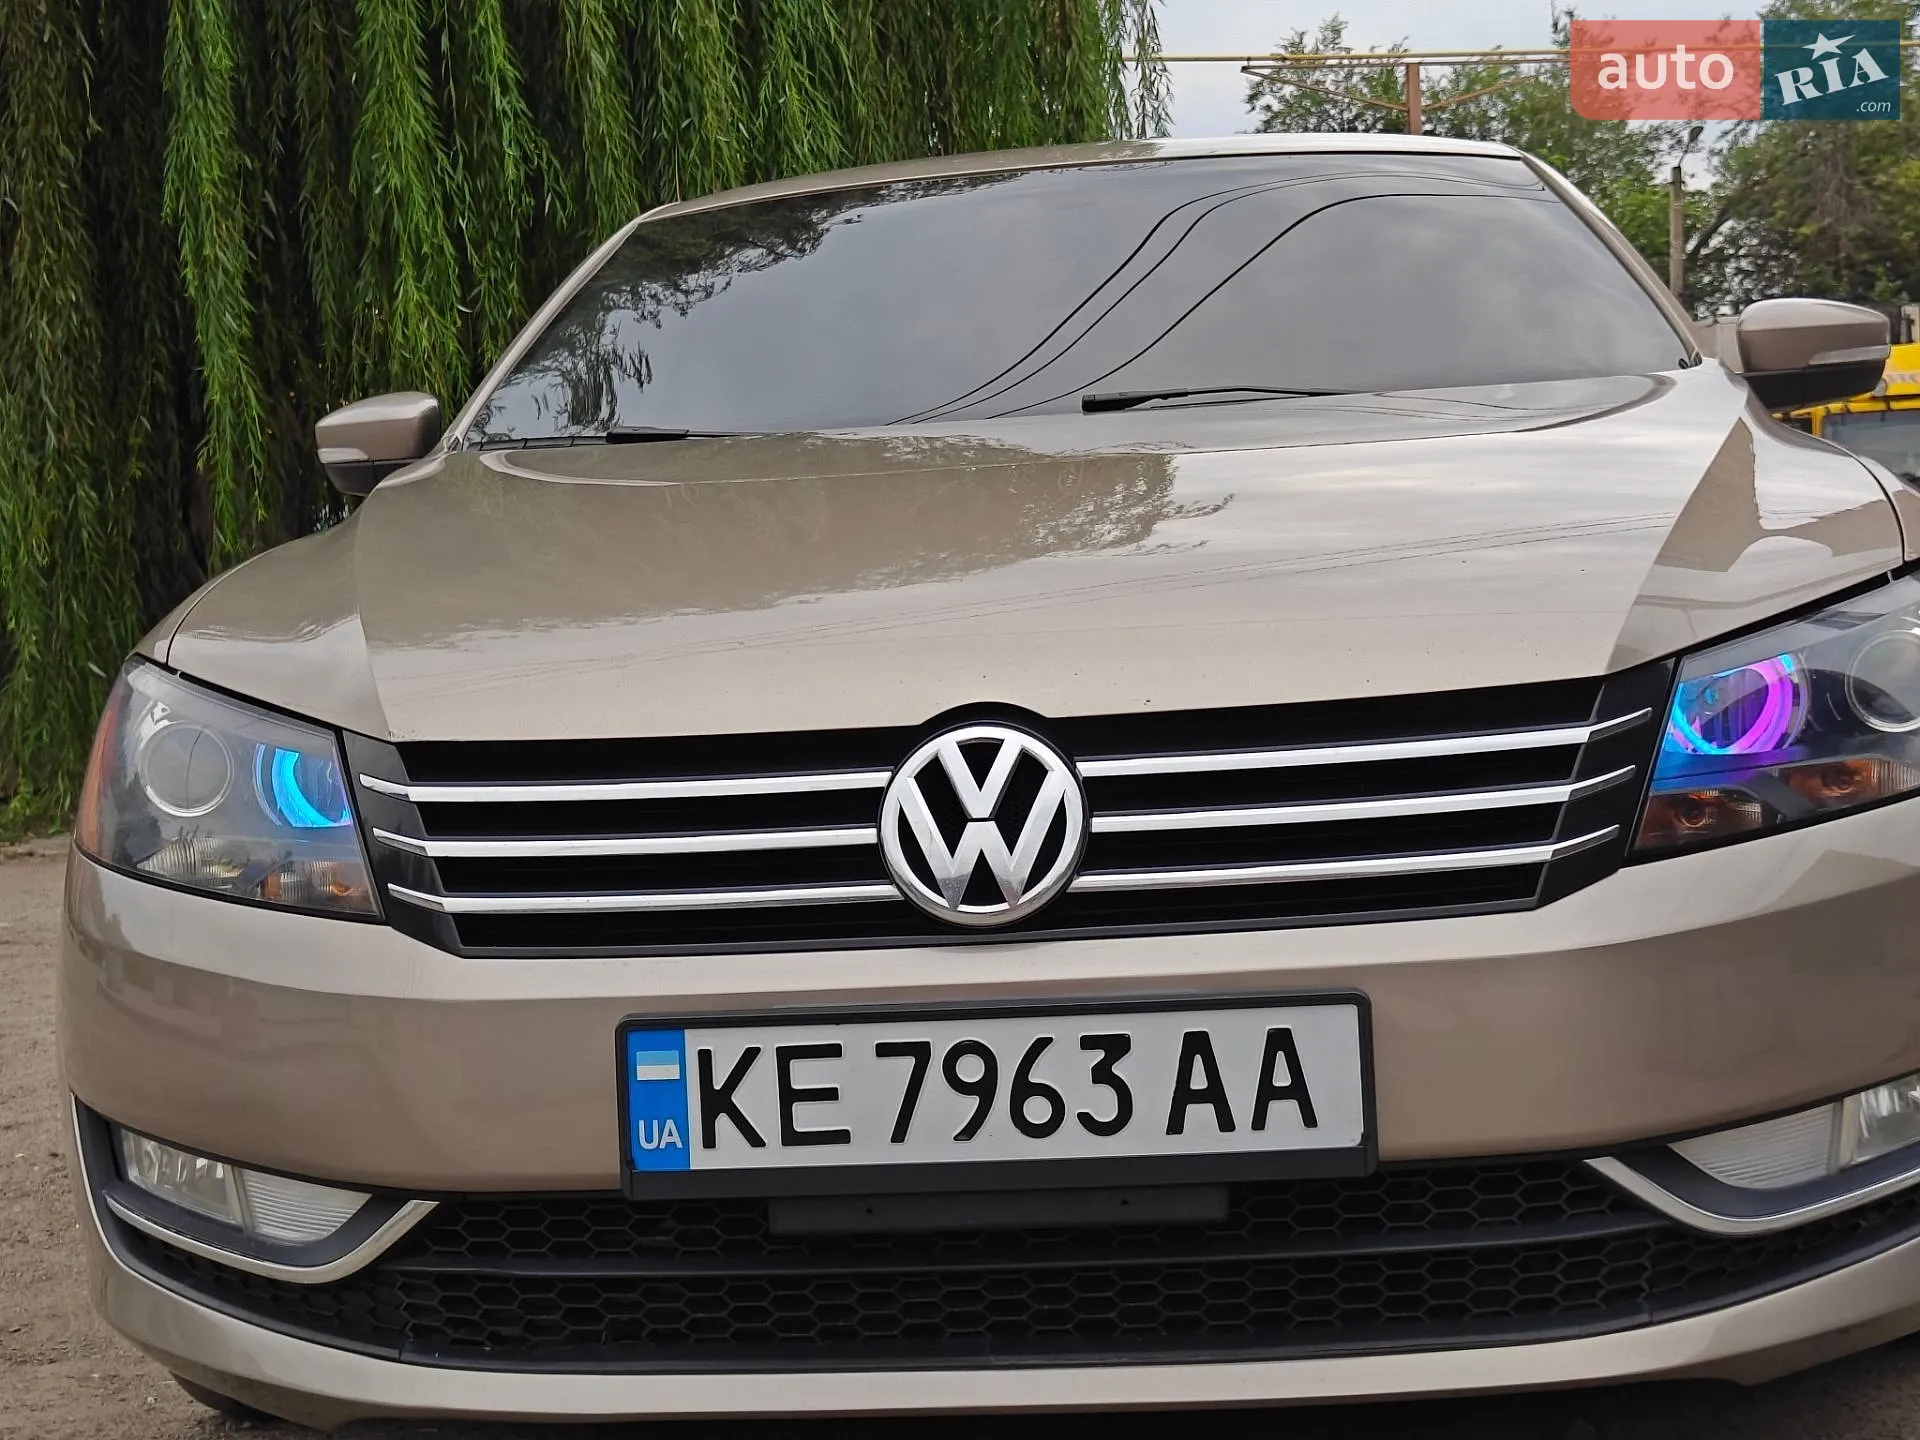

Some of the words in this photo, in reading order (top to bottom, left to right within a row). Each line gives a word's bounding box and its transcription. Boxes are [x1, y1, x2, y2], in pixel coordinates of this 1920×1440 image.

[886, 729, 1078, 913] VW
[637, 1118, 684, 1150] UA
[697, 1043, 852, 1149] KE
[874, 1032, 1134, 1144] 7963
[1165, 1027, 1319, 1136] AA
